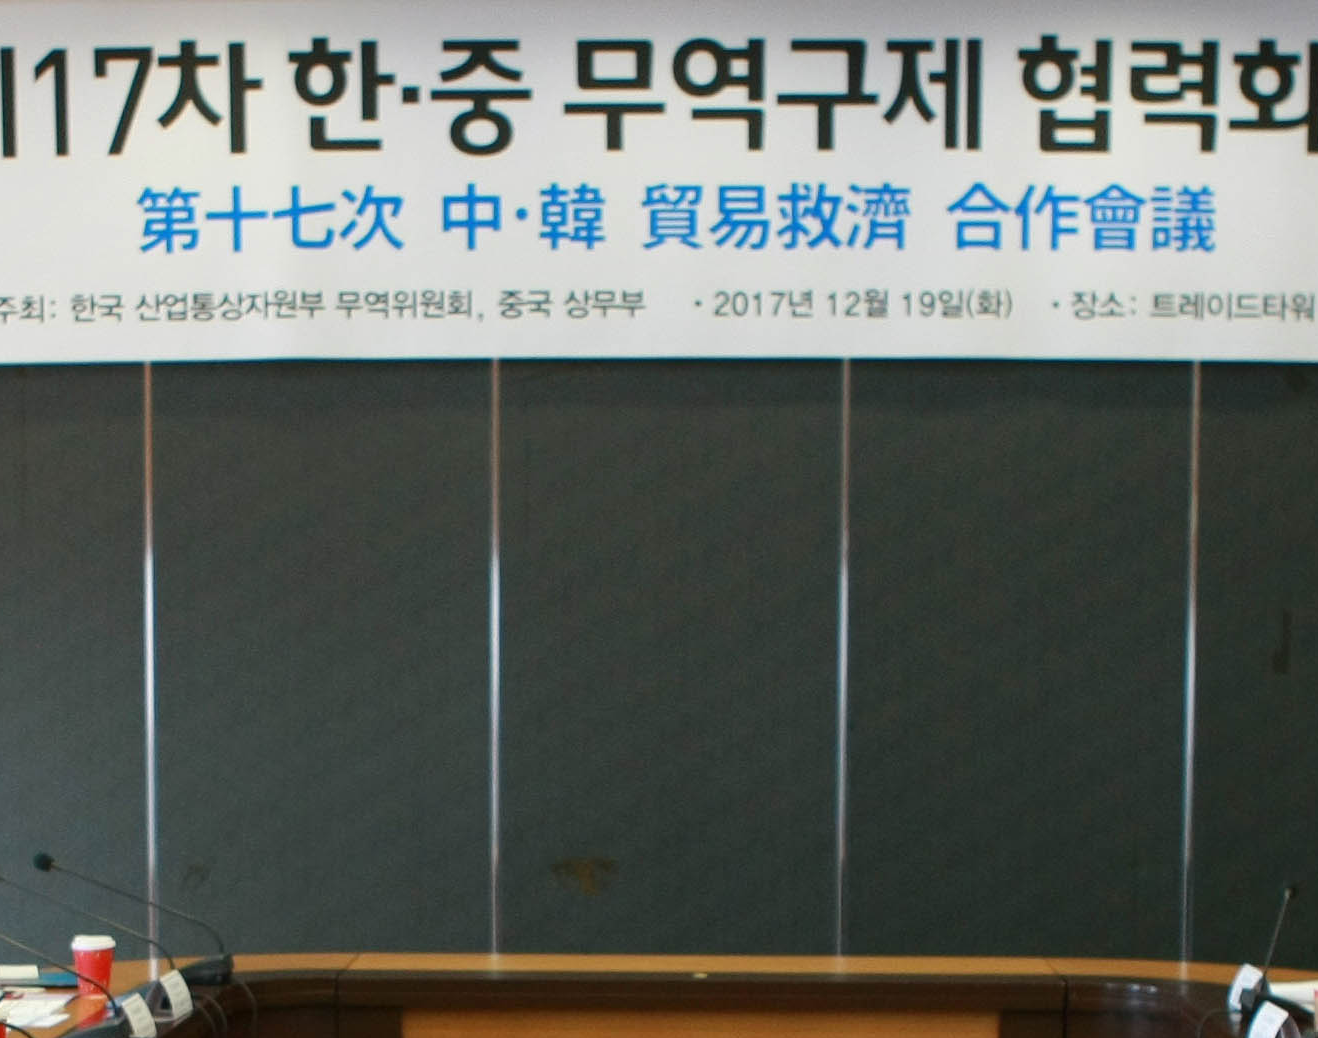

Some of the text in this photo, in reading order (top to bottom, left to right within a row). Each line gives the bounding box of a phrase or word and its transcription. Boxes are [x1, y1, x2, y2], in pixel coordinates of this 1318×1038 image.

[287, 36, 533, 157] 한·중
[563, 34, 984, 154] 무역구제
[136, 181, 1216, 254] 第十七次 中·韓 貿易救濟 合作會議
[71, 294, 124, 323] 한국
[136, 290, 325, 321] 산업통상자원부
[336, 290, 484, 321] 무역위원회,
[498, 290, 553, 320] 중국
[565, 289, 646, 319] 상무부
[713, 289, 1013, 319] 2017년 12월 19일(화)
[1151, 292, 1316, 322] 트레이드타워
